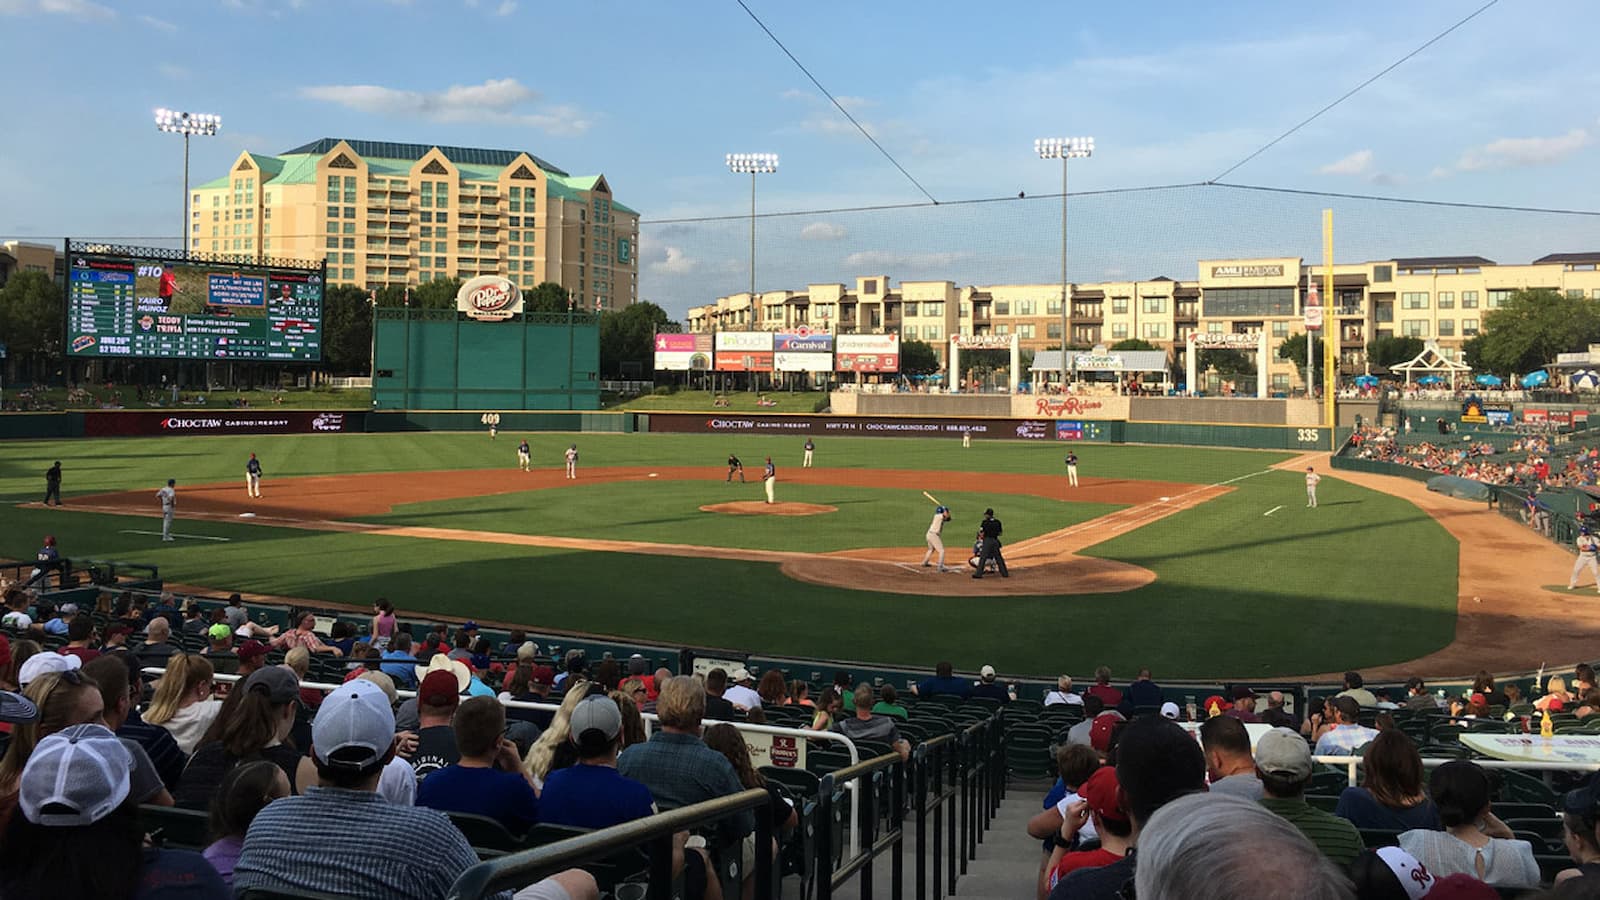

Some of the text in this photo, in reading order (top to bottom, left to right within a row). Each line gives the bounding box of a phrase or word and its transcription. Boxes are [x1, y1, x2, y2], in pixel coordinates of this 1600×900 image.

[138, 266, 162, 277] #10
[158, 316, 181, 324] TEDDY
[157, 325, 182, 333] TRIVIA
[1196, 333, 1260, 343] CHOCTAW
[791, 341, 826, 349] Carnival
[168, 417, 222, 428] CHOCTAW
[481, 413, 500, 424] 409
[711, 419, 754, 428] CHOCTAW
[1297, 428, 1319, 442] 335
